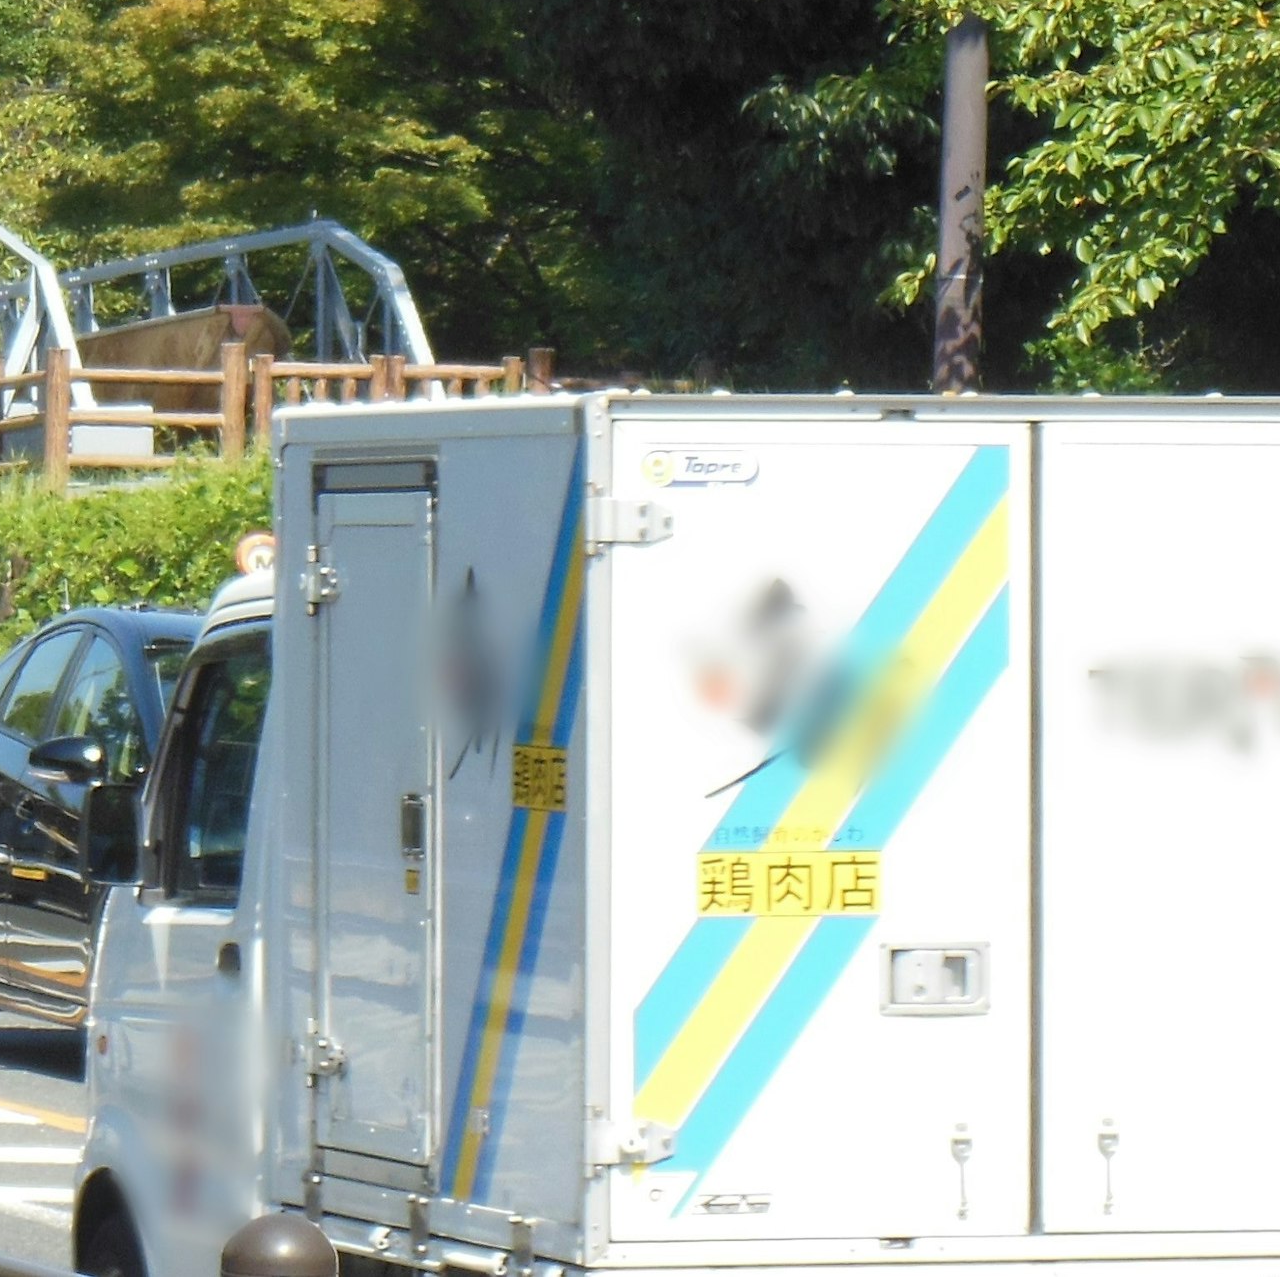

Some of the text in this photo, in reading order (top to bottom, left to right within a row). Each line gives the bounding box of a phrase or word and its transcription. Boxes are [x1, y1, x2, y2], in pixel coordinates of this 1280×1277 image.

[683, 456, 742, 475] Topre
[701, 855, 878, 913] 鶏肉店
